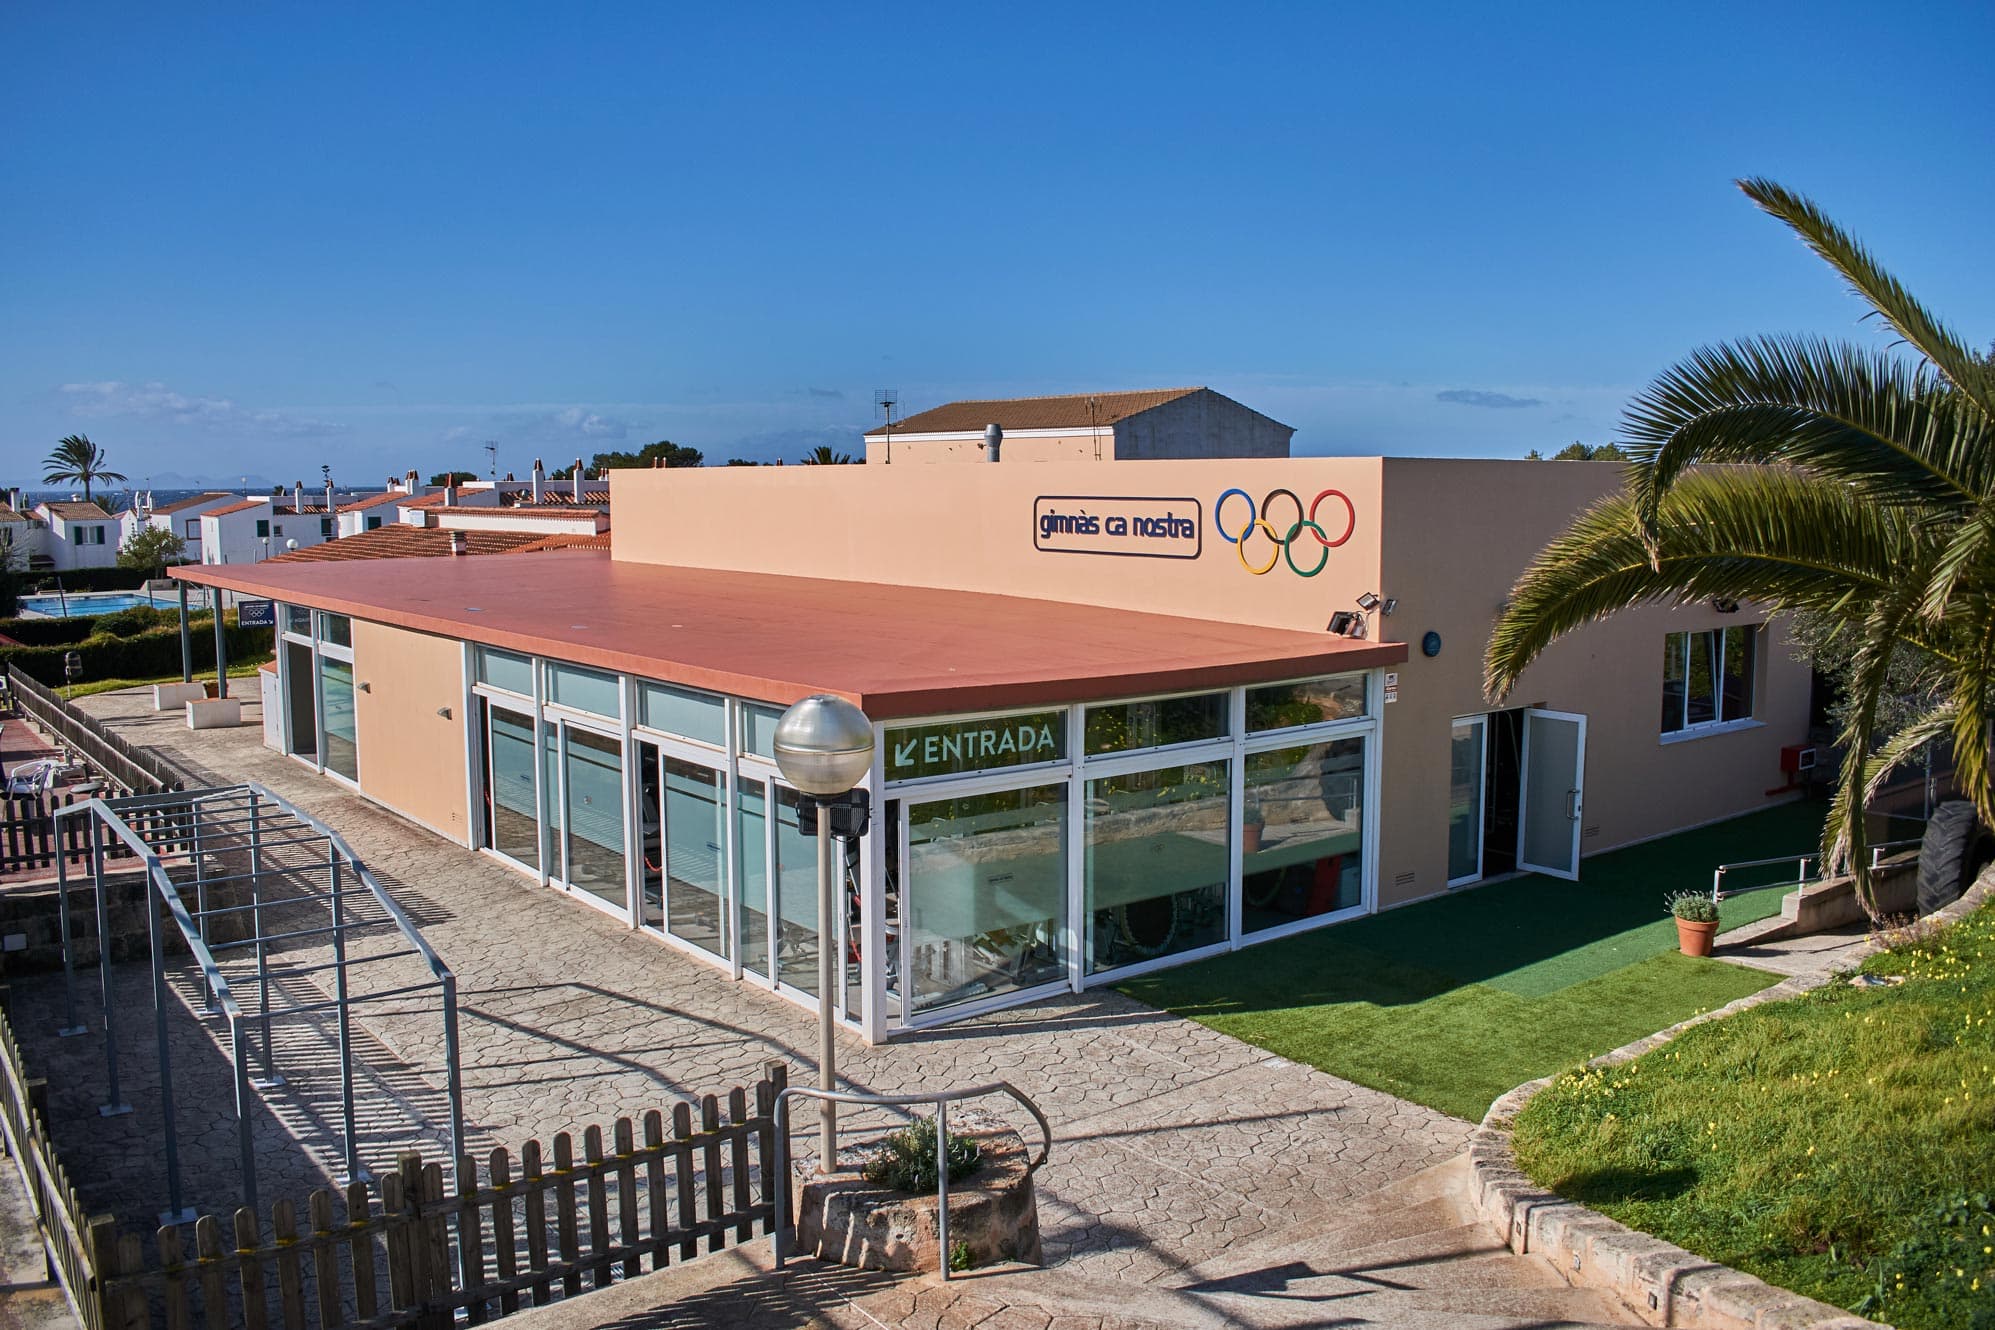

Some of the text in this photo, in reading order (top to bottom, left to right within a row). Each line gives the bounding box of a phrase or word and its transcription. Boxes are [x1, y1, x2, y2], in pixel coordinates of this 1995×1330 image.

[1040, 509, 1195, 539] gimnàs ca nostra
[924, 724, 1055, 764] ENTRADA
